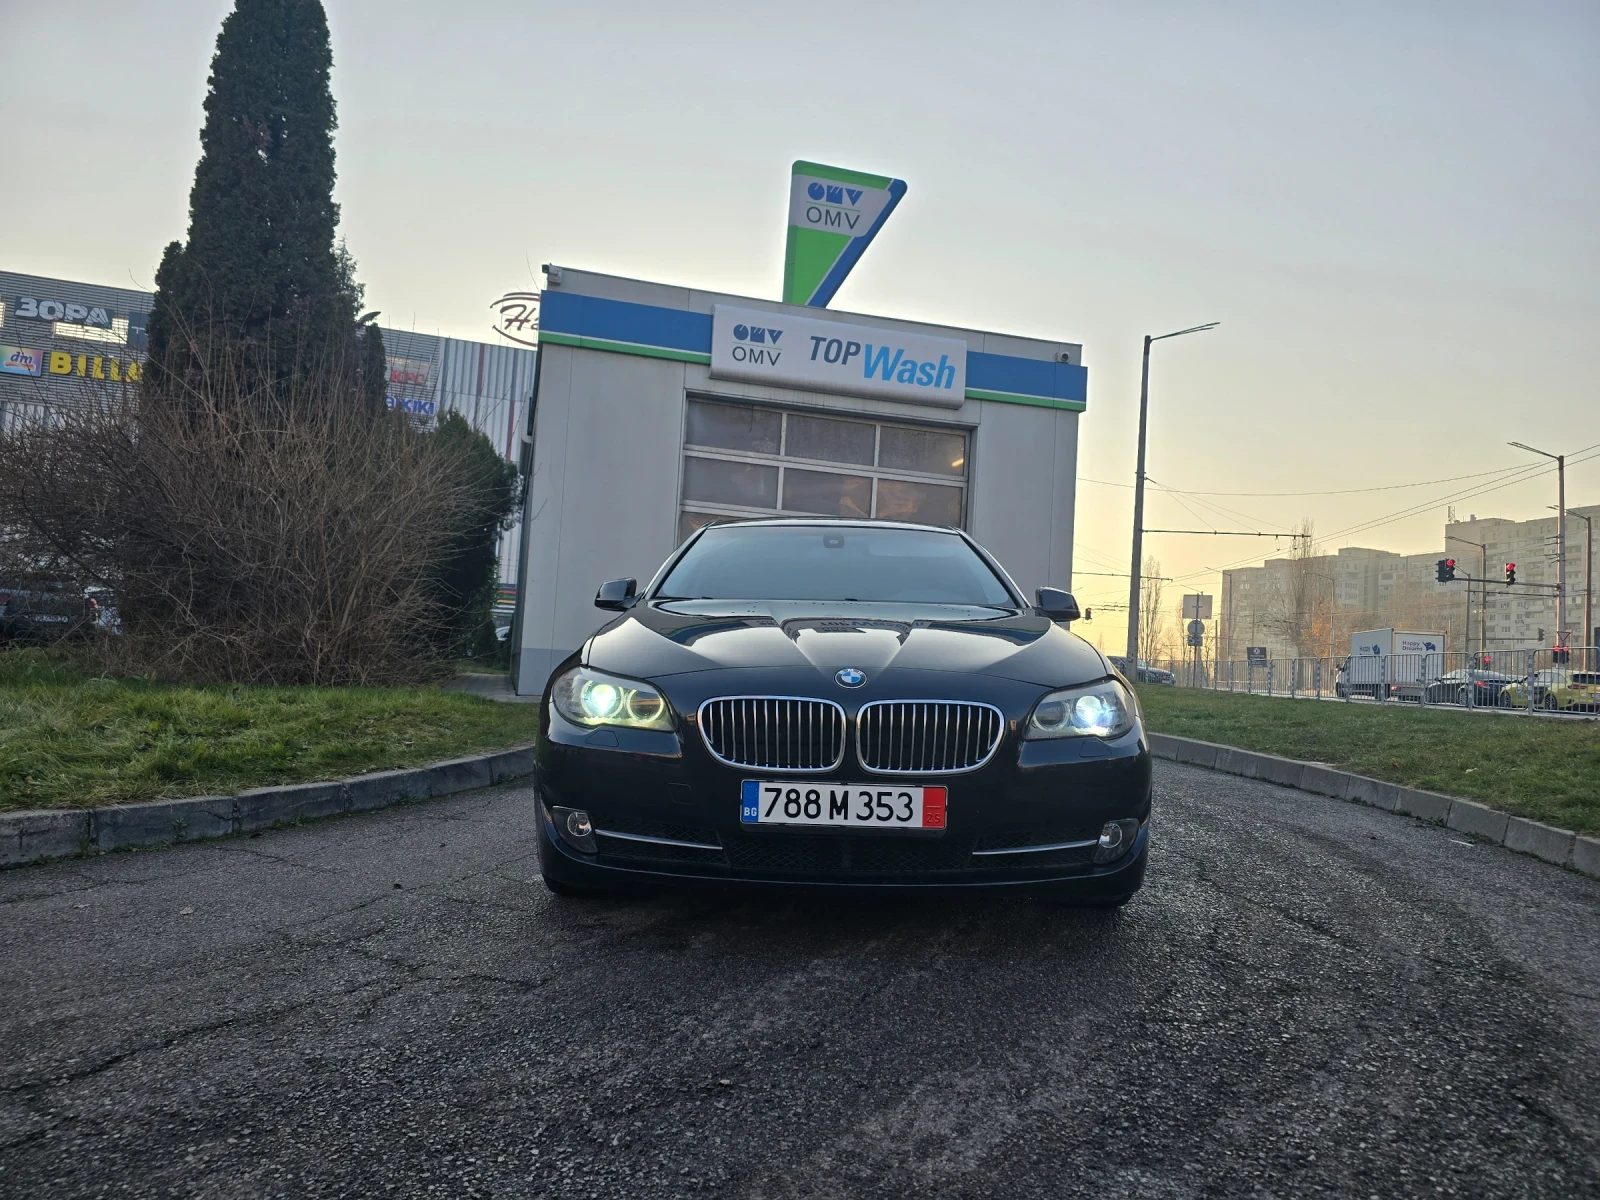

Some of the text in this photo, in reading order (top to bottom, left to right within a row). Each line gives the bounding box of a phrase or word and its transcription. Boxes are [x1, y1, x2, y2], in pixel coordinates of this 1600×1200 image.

[806, 206, 860, 230] OMV
[15, 297, 110, 327] ЗОРА
[10, 351, 33, 364] dm
[49, 350, 143, 383] BILLA
[732, 346, 781, 367] OMV
[810, 335, 956, 390] TOP Wash
[743, 807, 757, 817] BG
[764, 787, 914, 822] 788 M 353
[926, 812, 941, 824] 25
